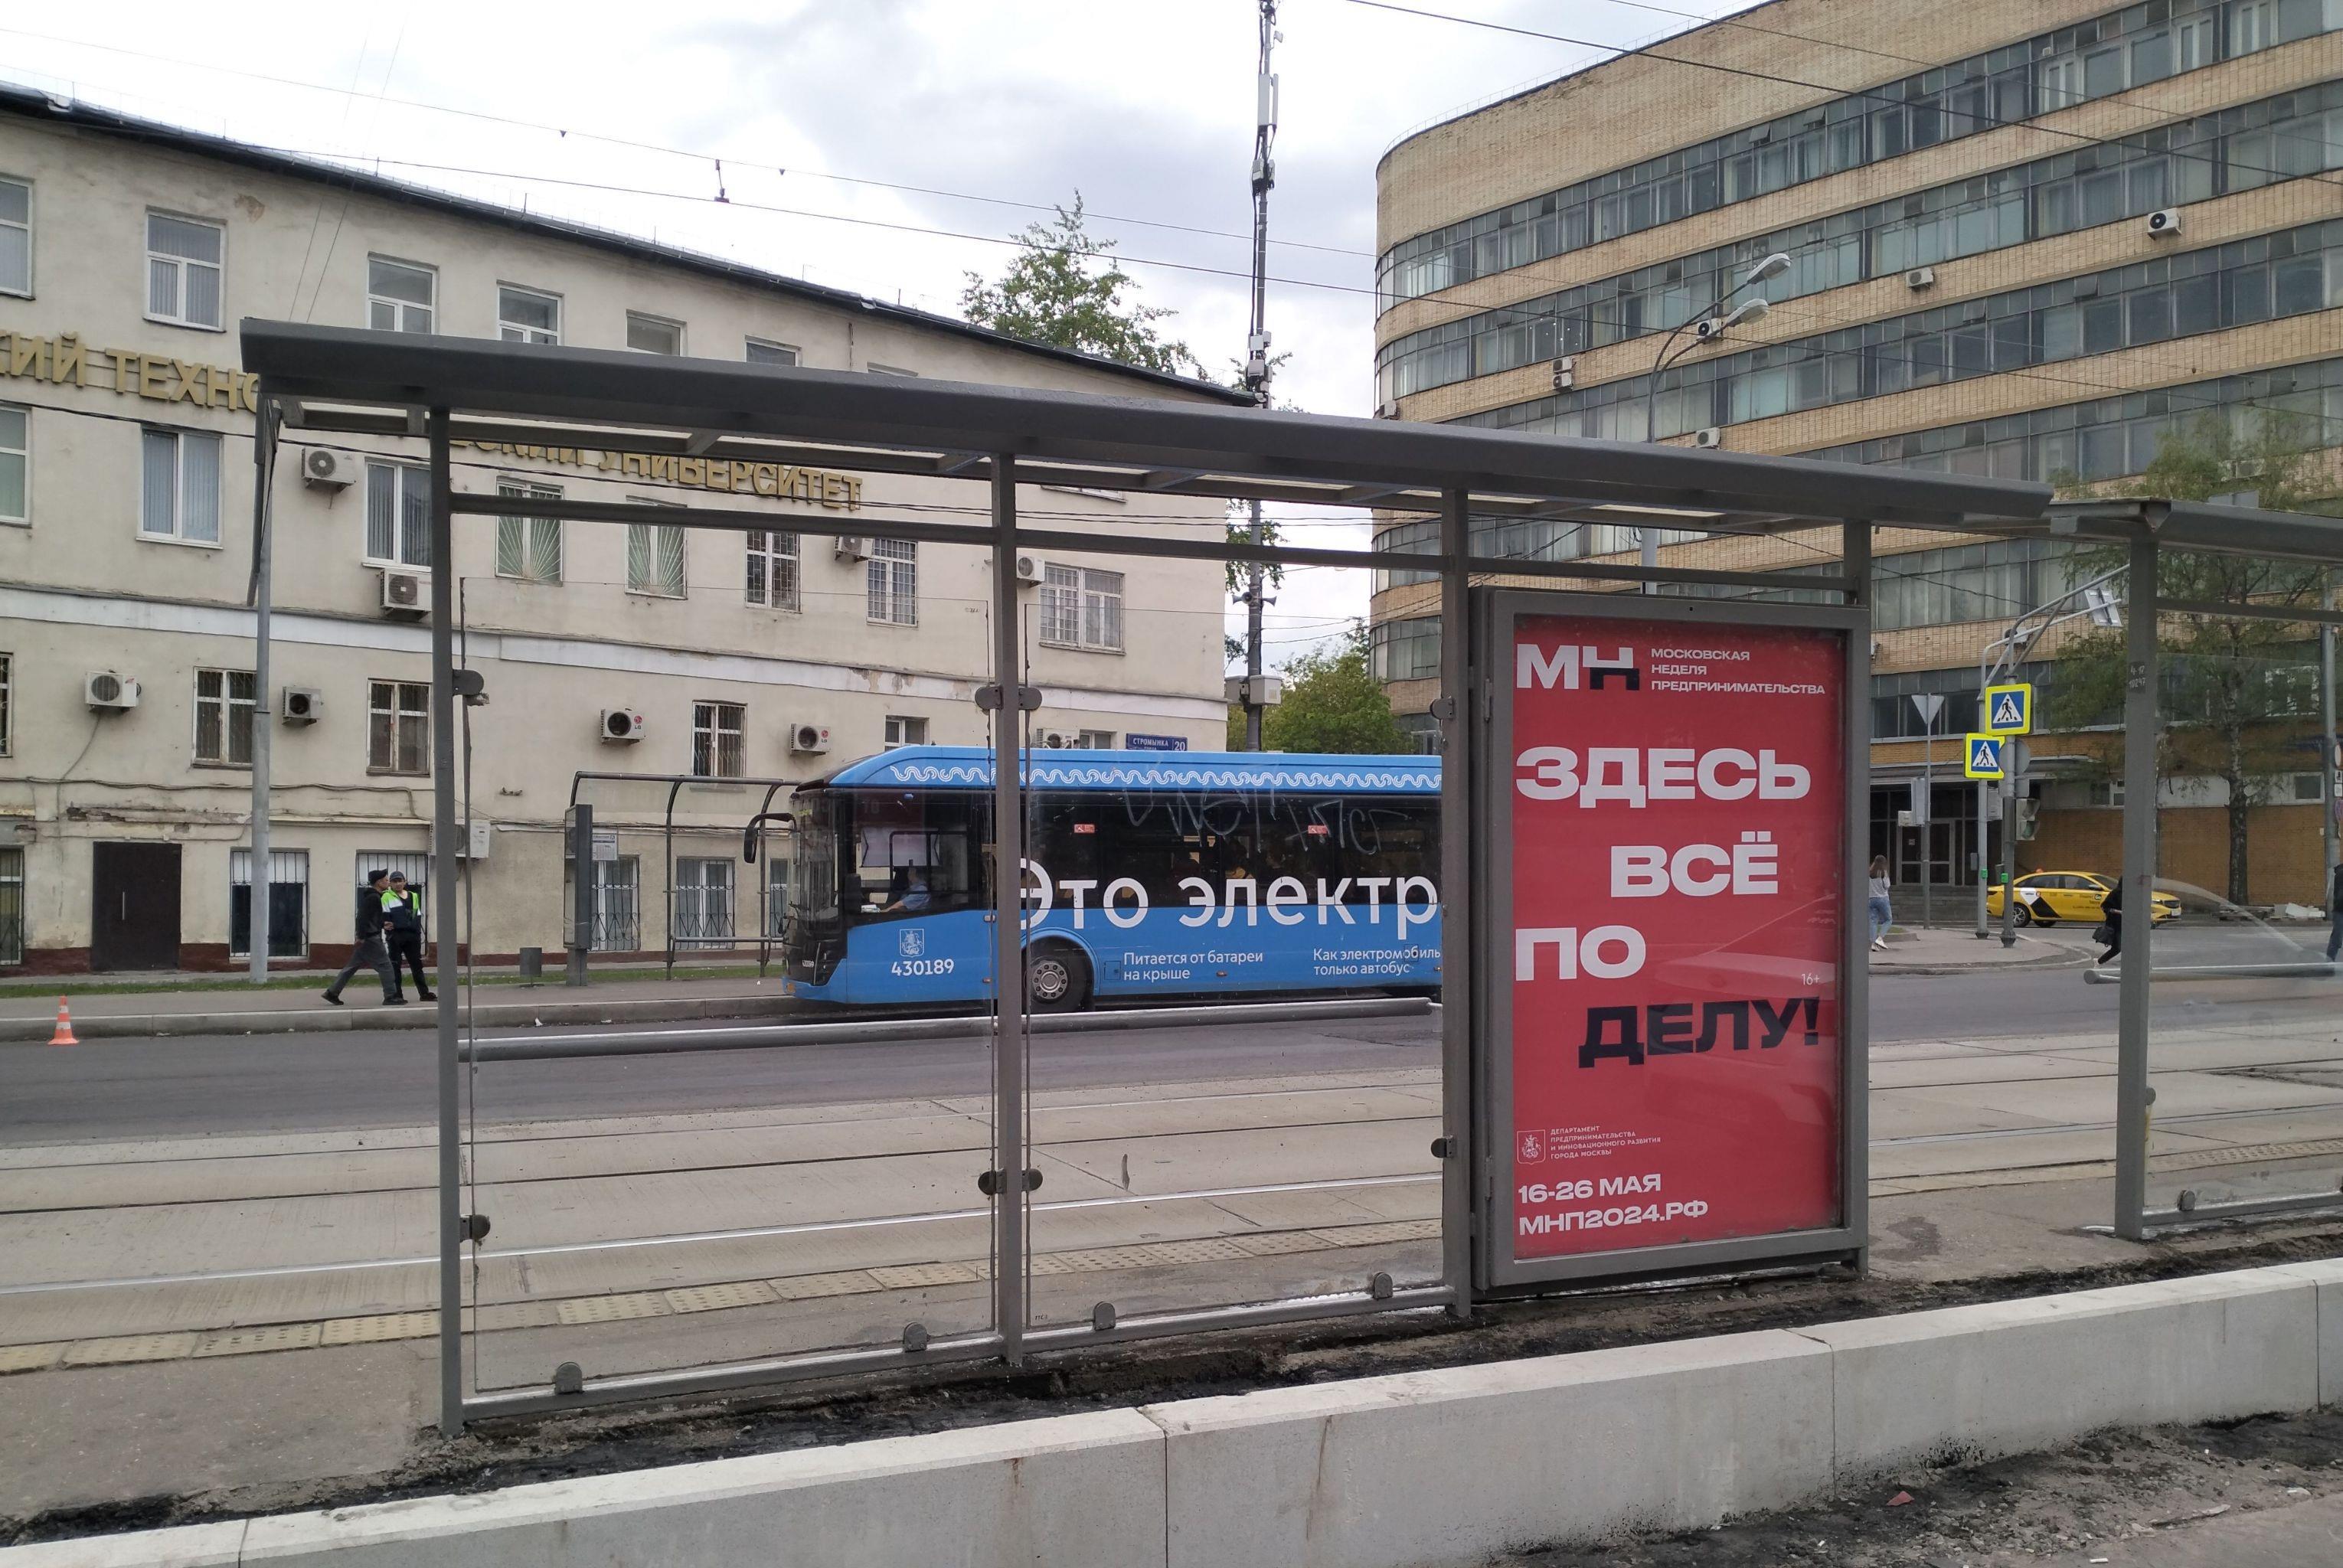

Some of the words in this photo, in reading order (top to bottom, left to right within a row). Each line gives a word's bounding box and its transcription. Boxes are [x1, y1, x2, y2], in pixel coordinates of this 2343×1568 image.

[0, 329, 86, 387] ИЙ
[1651, 648, 1750, 661] МОСКОВСКАЯ
[1651, 664, 1707, 676] НЕДЕЛЯ
[1651, 681, 1825, 694] ПРЕДПРИНИМАТЕЛЬСТВА
[1132, 737, 1169, 746] СТРОМЫНКА
[1174, 740, 1186, 751] 20
[1516, 746, 1811, 808] ЗДЕСЬ
[1610, 831, 1778, 897] ВСЁ
[1123, 952, 1187, 965] Питается
[1190, 953, 1205, 964] от
[1207, 949, 1263, 965] батареи
[1313, 948, 1338, 961] Как
[1340, 946, 1441, 962] электромобиль
[1515, 925, 1646, 982] ПО
[890, 958, 955, 977] 430189
[1314, 965, 1358, 975] только
[1360, 961, 1410, 976] автобус
[1123, 970, 1140, 981] на
[1143, 969, 1191, 983] крыше
[1801, 972, 1820, 986] 16+
[1578, 995, 1819, 1069] ДЕЛУ!
[1551, 1125, 1600, 1135] ДЕПАРТАМЕНТ
[1551, 1131, 1636, 1143] ПРЕДПРИНИМАТЕЛЬСТВА
[1557, 1140, 1626, 1150] ИННОВАЦИОННОГО
[1627, 1137, 1662, 1145] РАЗВИТИЯ
[1580, 1149, 1612, 1158] МОСКВЫ
[1518, 1180, 1593, 1204] 16-26
[1600, 1174, 1661, 1197] МАЯ
[1519, 1200, 1708, 1236] МНП2024.РФ
